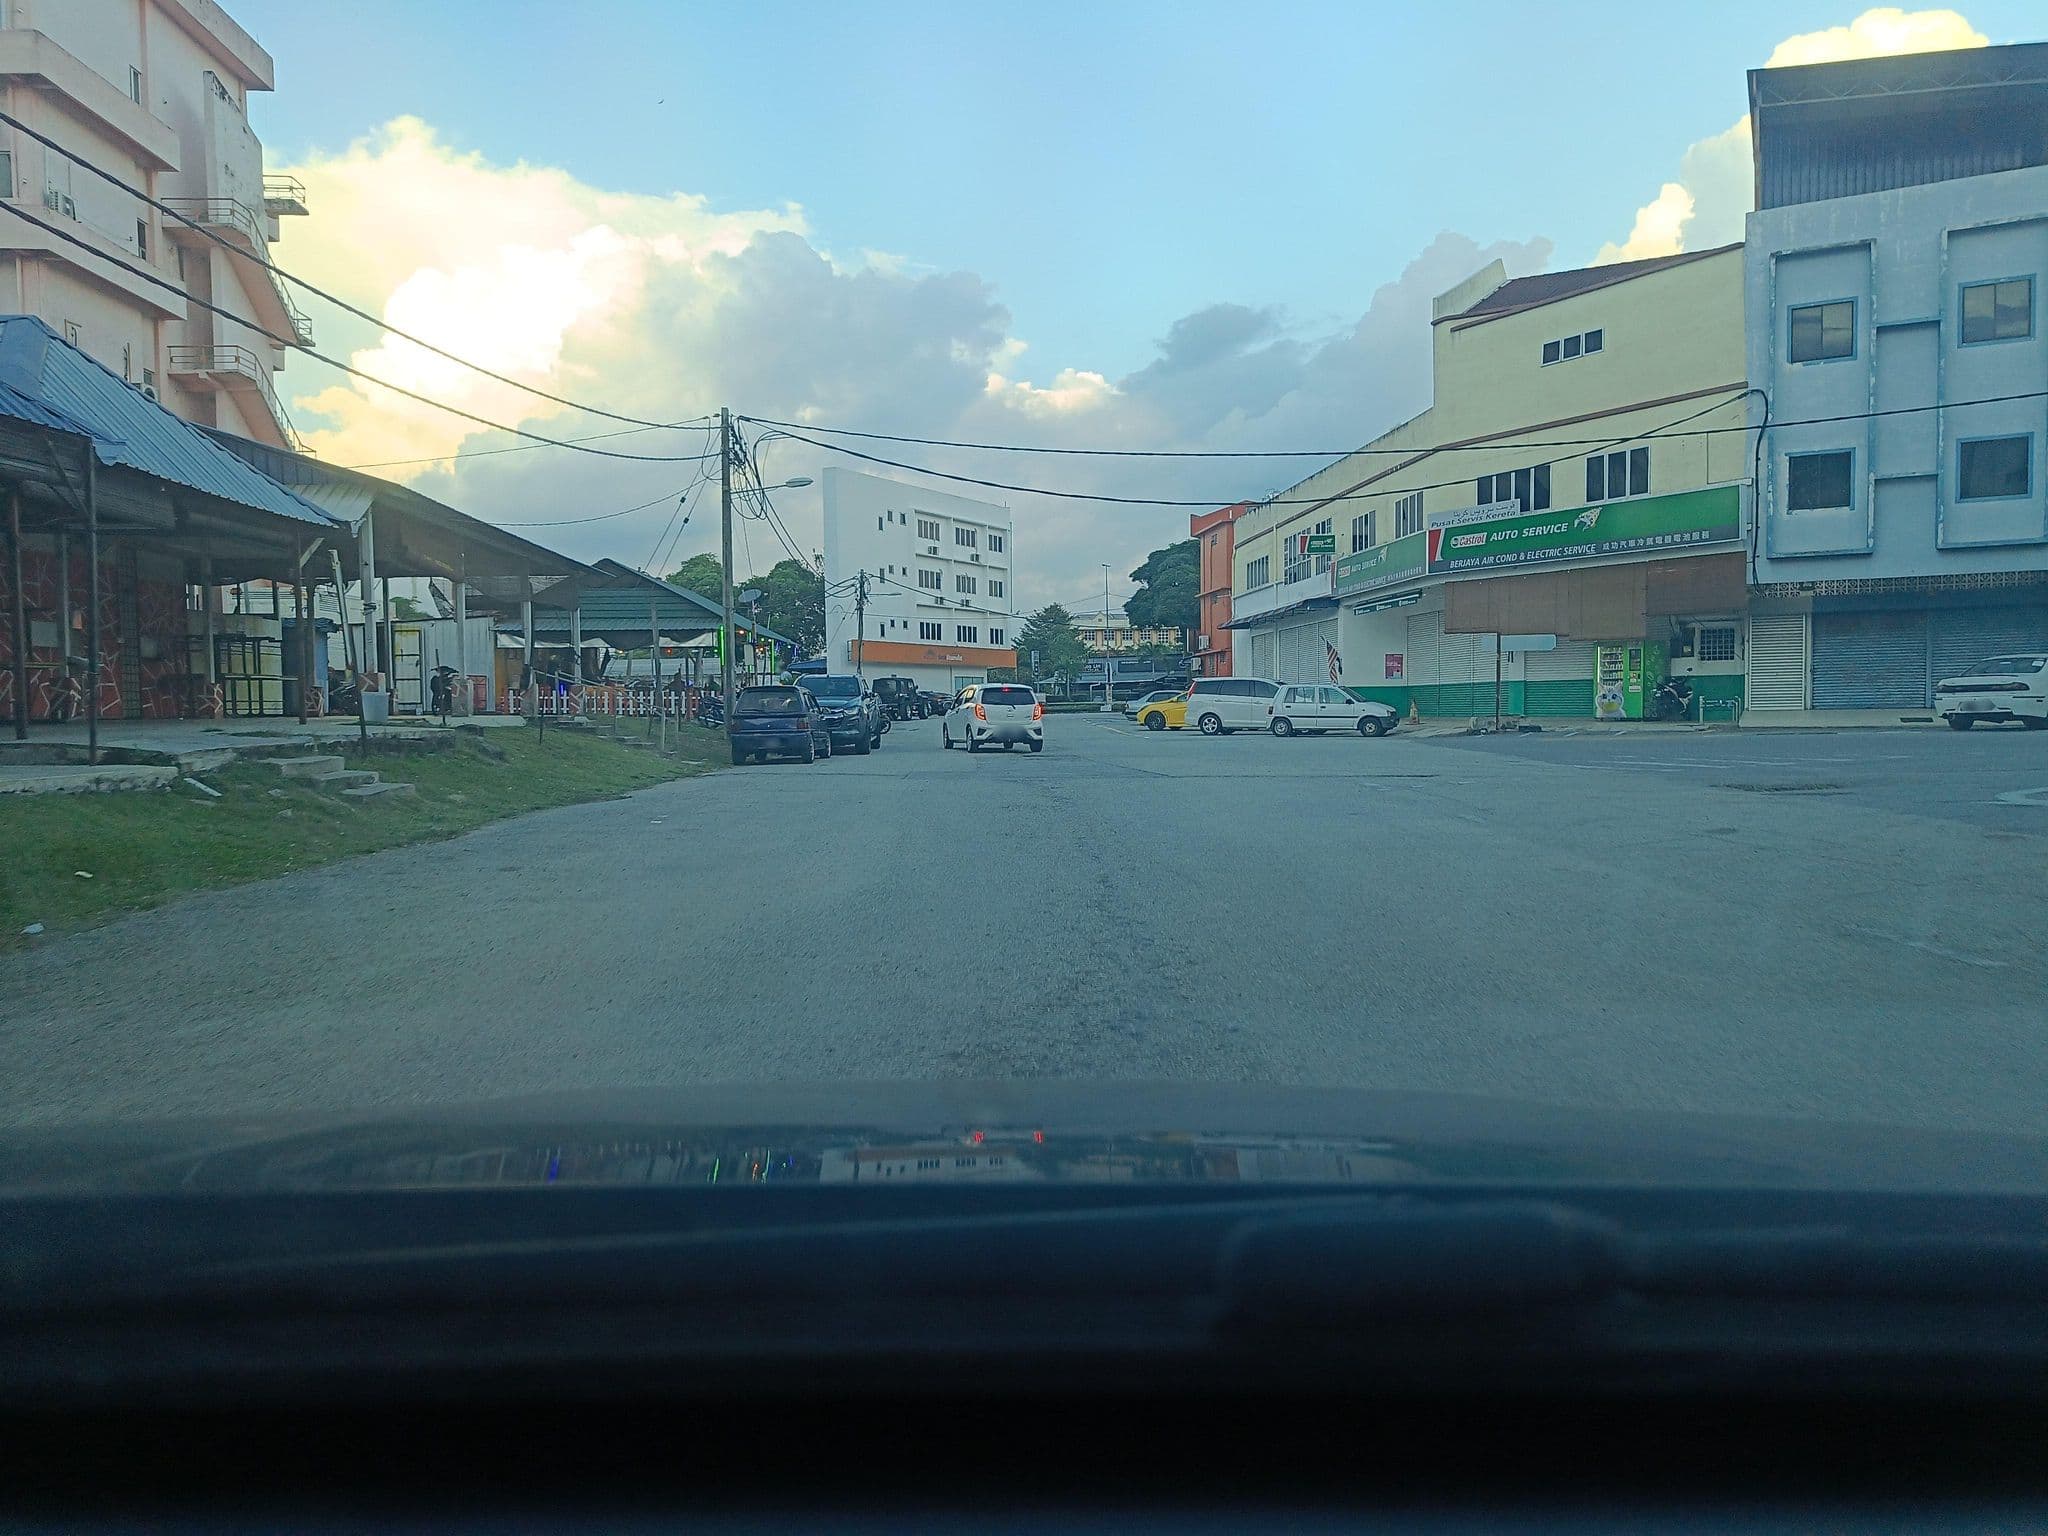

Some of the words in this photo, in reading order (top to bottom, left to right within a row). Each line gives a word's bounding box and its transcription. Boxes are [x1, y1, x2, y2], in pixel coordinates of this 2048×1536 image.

[1431, 519, 1455, 529] Pusat
[1457, 515, 1485, 525] Servis
[1485, 510, 1517, 521] Kereta
[1459, 534, 1485, 547] Castrol
[1490, 529, 1519, 542] AUTO
[1522, 522, 1569, 538] SERVICE
[1450, 557, 1480, 569] BERJAYA
[1481, 555, 1495, 565] AIR
[1495, 552, 1518, 563] COND
[1519, 551, 1526, 561] &
[1526, 547, 1563, 560] ELECTRIC
[1563, 544, 1597, 556] SERVICE
